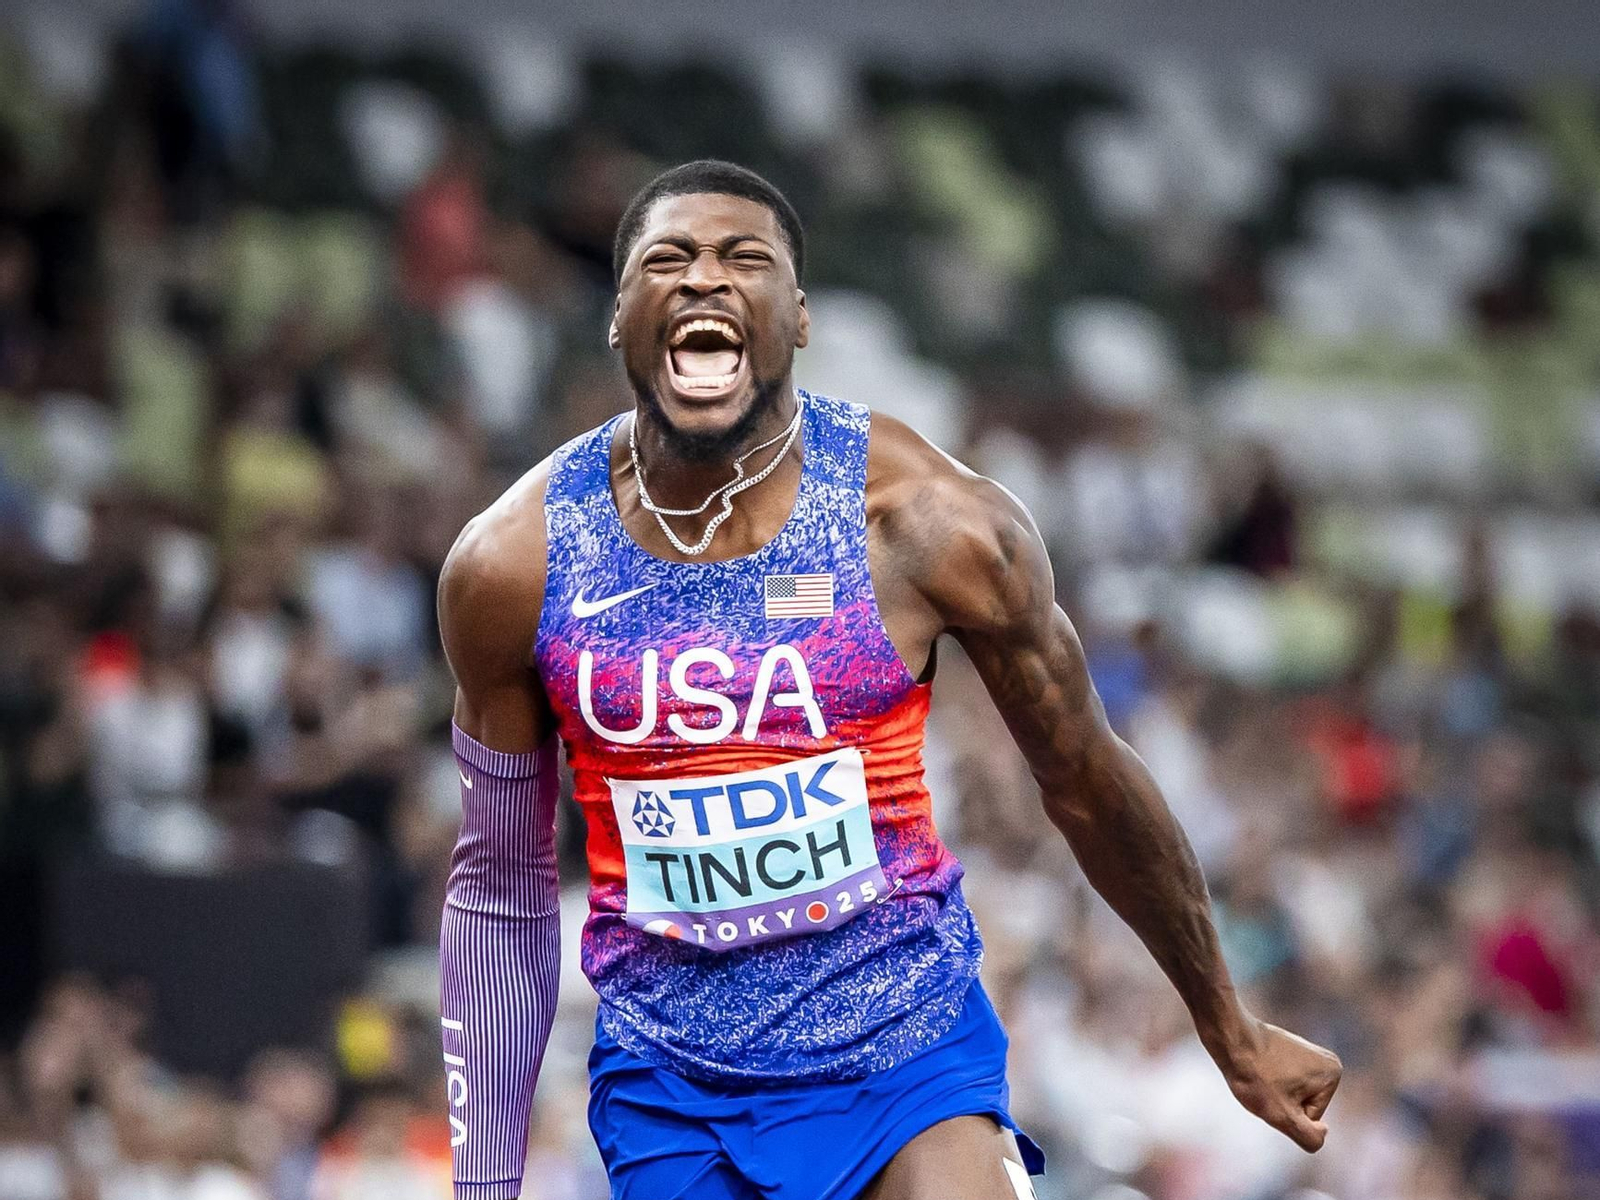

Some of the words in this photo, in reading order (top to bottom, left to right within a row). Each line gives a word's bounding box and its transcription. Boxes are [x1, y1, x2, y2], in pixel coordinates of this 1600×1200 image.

[578, 644, 827, 745] USA
[670, 760, 846, 836] TDK
[645, 818, 852, 904] TINCH
